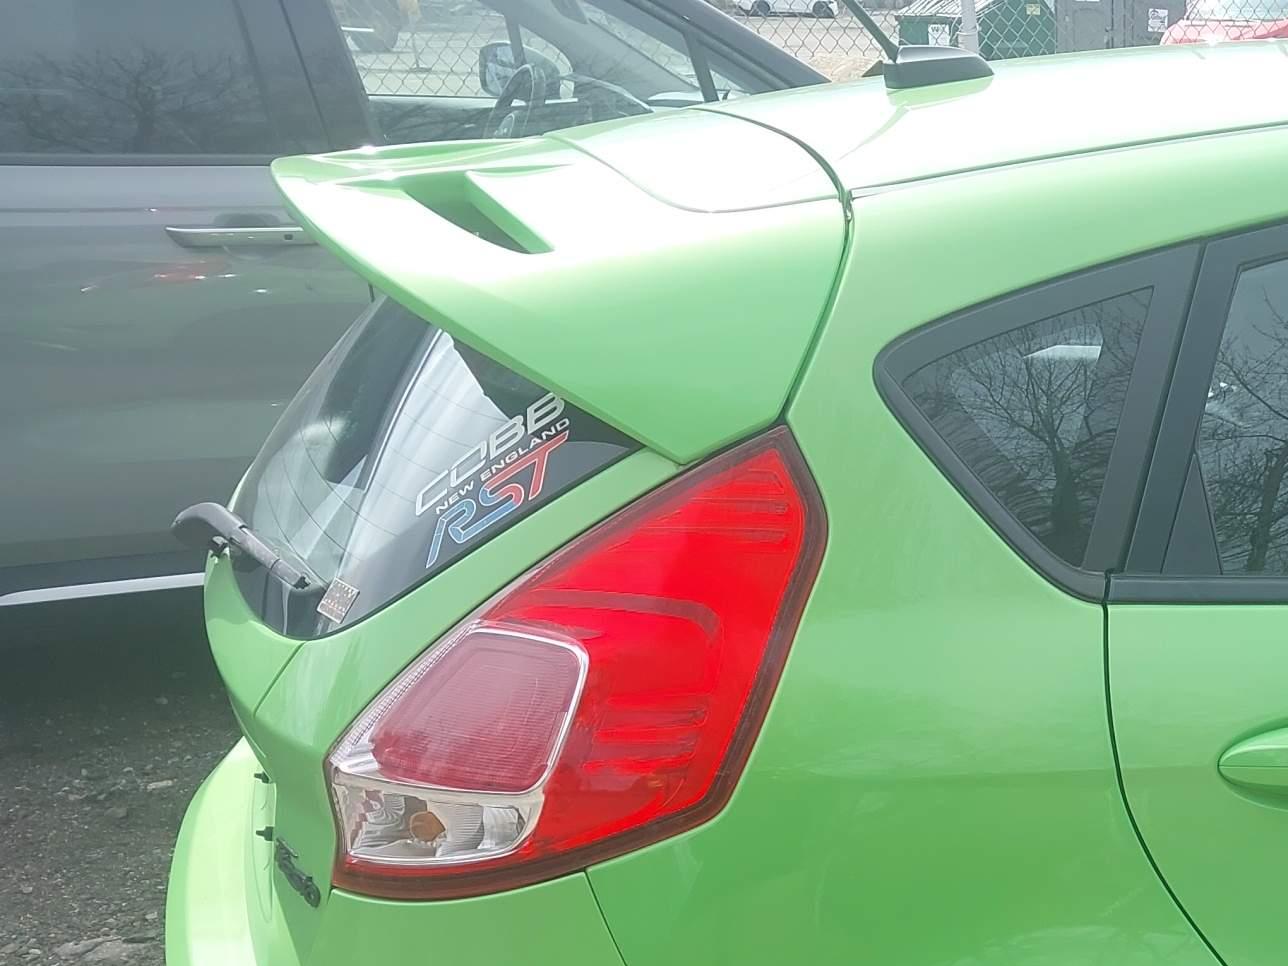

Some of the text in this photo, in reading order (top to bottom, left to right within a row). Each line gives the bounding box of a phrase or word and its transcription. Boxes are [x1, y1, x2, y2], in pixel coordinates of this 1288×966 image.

[415, 392, 565, 516] COBB
[426, 430, 570, 568] RST
[435, 418, 570, 515] NEW ENGLAND
